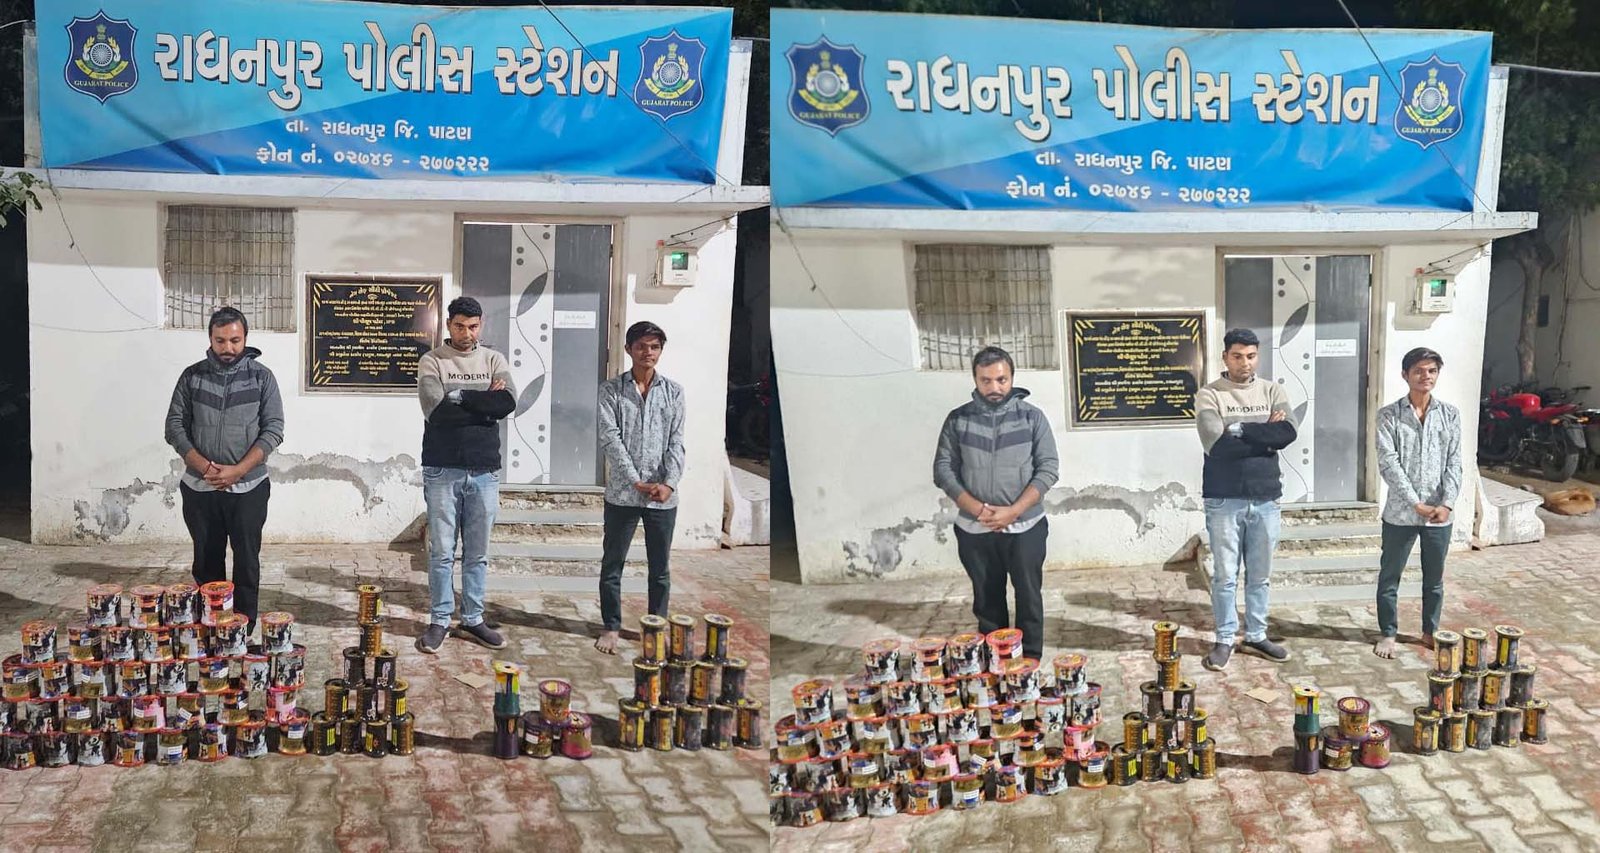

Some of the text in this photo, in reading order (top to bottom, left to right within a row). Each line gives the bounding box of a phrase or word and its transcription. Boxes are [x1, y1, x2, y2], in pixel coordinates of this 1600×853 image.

[154, 21, 619, 111] રાધનપુર પોલીસ સ્ટેશન
[670, 99, 694, 107] POLICE
[886, 45, 1380, 142] રાધનપુર પોલીસ સ્ટેશન
[800, 111, 833, 119] GUJARAT
[285, 120, 472, 142] તા. રાધનપુર જિ. પાટણ
[256, 141, 292, 164] ફોન
[301, 143, 322, 164] નં.
[333, 150, 393, 167] ૦૨૭૪૬
[420, 154, 489, 172] ૨૭૭૨૨૨
[1035, 150, 1231, 175] તા. રાધનપુર જિ. પાટણ
[1006, 175, 1045, 199] ફોન
[1054, 176, 1077, 198] નં.
[1089, 183, 1151, 200] ૦૨૭૪૬
[1178, 186, 1251, 204] ૨૭૭૨૨૨
[448, 372, 490, 380] MODERN
[1227, 404, 1269, 413] MODERN
